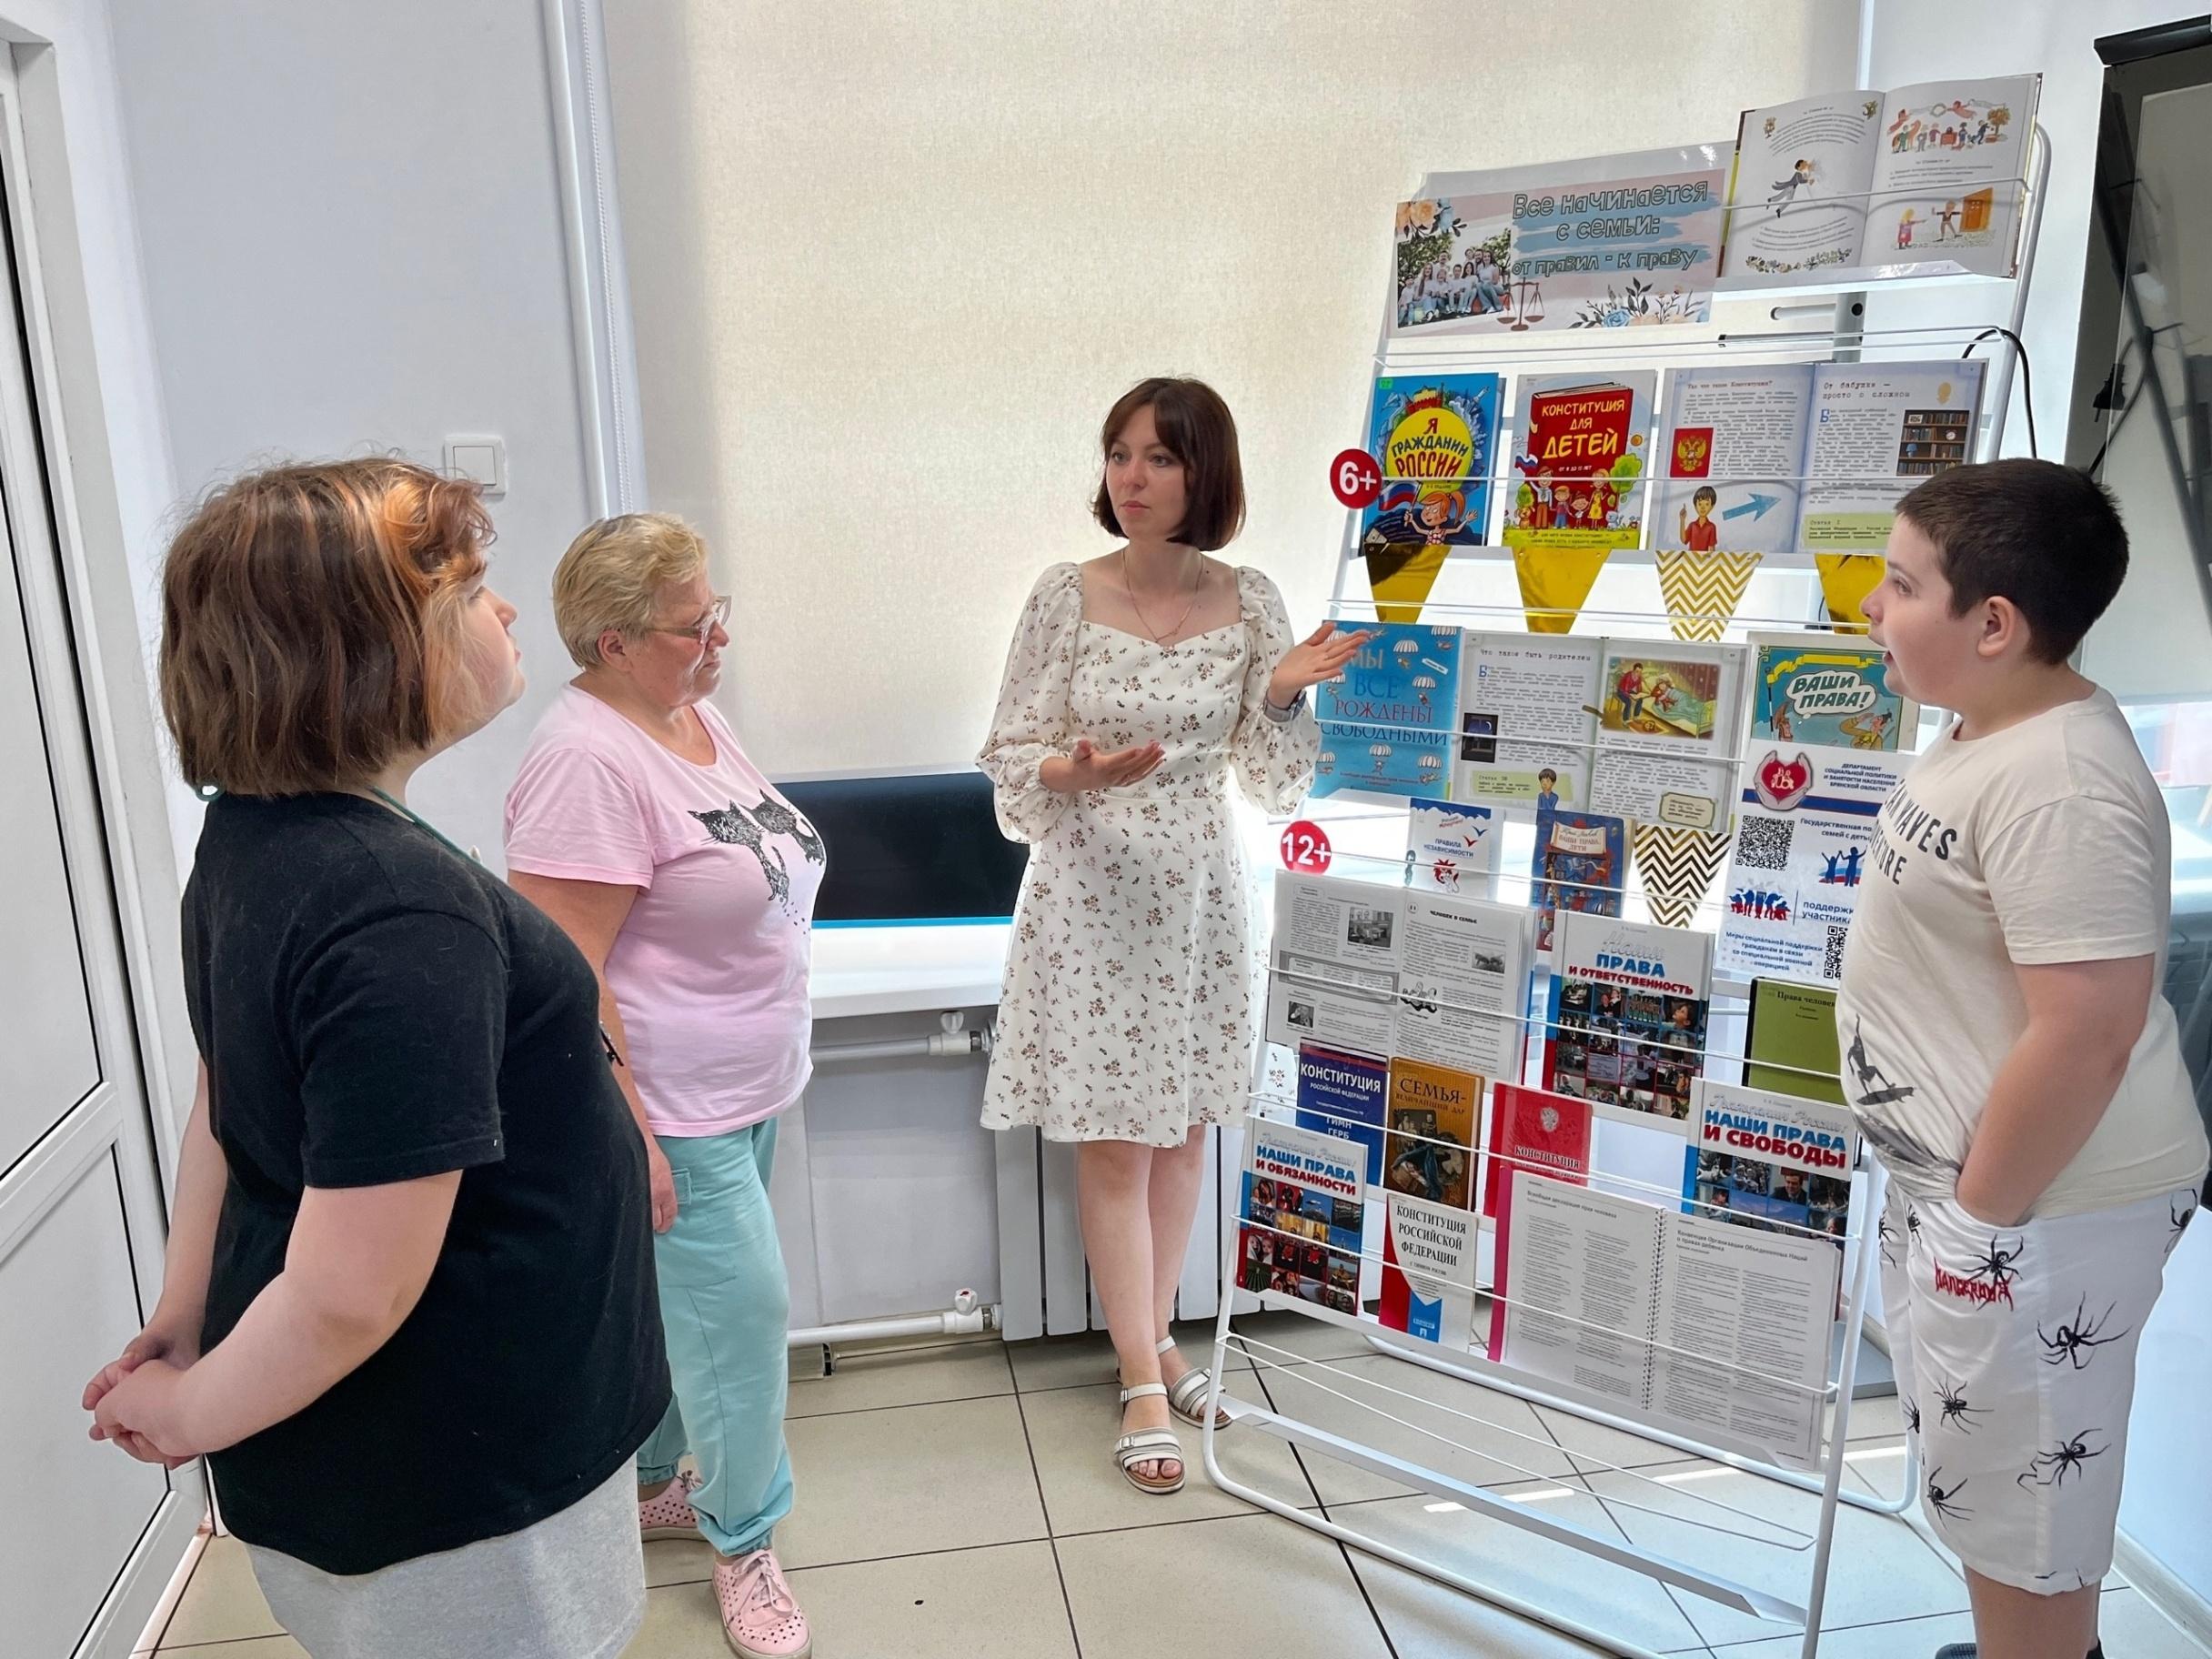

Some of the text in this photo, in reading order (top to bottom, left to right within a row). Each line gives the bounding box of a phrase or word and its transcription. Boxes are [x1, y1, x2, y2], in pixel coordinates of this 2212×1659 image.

[1513, 181, 1708, 219] Все начинается
[1556, 215, 1661, 241] с семьи:
[1512, 261, 1531, 276] от
[1534, 255, 1600, 277] правил
[1617, 253, 1633, 269] к
[1637, 248, 1699, 271] праву
[1542, 399, 1625, 417] КОНСТИТУЦИЯ
[1423, 417, 1439, 435] Я
[1569, 417, 1594, 431] ДЛЯ
[1392, 436, 1470, 458] ГРАЖДАНИН
[1542, 427, 1619, 459] ДЕТЕЙ
[1394, 451, 1463, 479] РОССИИ
[1340, 460, 1378, 495] 6+
[1354, 673, 1399, 699] ВСЕ
[1792, 675, 1856, 695] ВАШИ
[1335, 698, 1433, 724] РОЖДЕНЫ
[1799, 691, 1872, 709] ПРАВА!
[1321, 722, 1448, 747] СВОБОДНЫМИ
[1825, 768, 1897, 779] СОЦИАЛЬНОЙ ПОЛИТИКИ
[1842, 763, 1882, 772] ДЕПАРТАМЕНТ
[1860, 784, 1886, 792] ОБЛАСТИ
[1800, 818, 1862, 831] Государственная
[1822, 830, 1844, 838] семей
[1282, 832, 1331, 866] 12+
[1423, 844, 1473, 858] НЕЗАВИСИМОСТИ
[1435, 838, 1462, 848] ПРАВИЛА
[1804, 901, 1854, 914] поддержк
[1726, 931, 1823, 951] Меры социальной поддержки
[1742, 942, 1777, 952] гражданам
[1596, 953, 1665, 978] ПРАВА
[1741, 950, 1783, 961] специальной
[1785, 958, 1812, 966] военной
[1754, 960, 1790, 970] операцией
[1569, 965, 1694, 996] И ОТВЕТСТВЕННОСТЬ
[1777, 991, 1835, 1007] Права человек
[1301, 1062, 1381, 1093] КОНСТИТУЦИЯ
[1310, 1082, 1370, 1101] РОССИЙСКОЙ ФЕДЕРАЦИИ
[1326, 1116, 1352, 1129] ГИМН
[1705, 1109, 1846, 1151] НАШИ ПРАВА
[1328, 1128, 1350, 1140] ГЕРБ
[1515, 1146, 1580, 1169] КОНСТИТУЦИЯ
[1704, 1124, 1846, 1170] И СВОБОДЫ
[1256, 1144, 1356, 1182] НАШИ ПРАВА
[1256, 1159, 1356, 1196] И ОБЯЗАННОСТИ
[1397, 1205, 1466, 1234] КОНСТИТУЦИЯ
[1399, 1222, 1463, 1251] РОССИЙСКОЙ
[1402, 1241, 1457, 1267] ФЕДЕРАЦИИ
